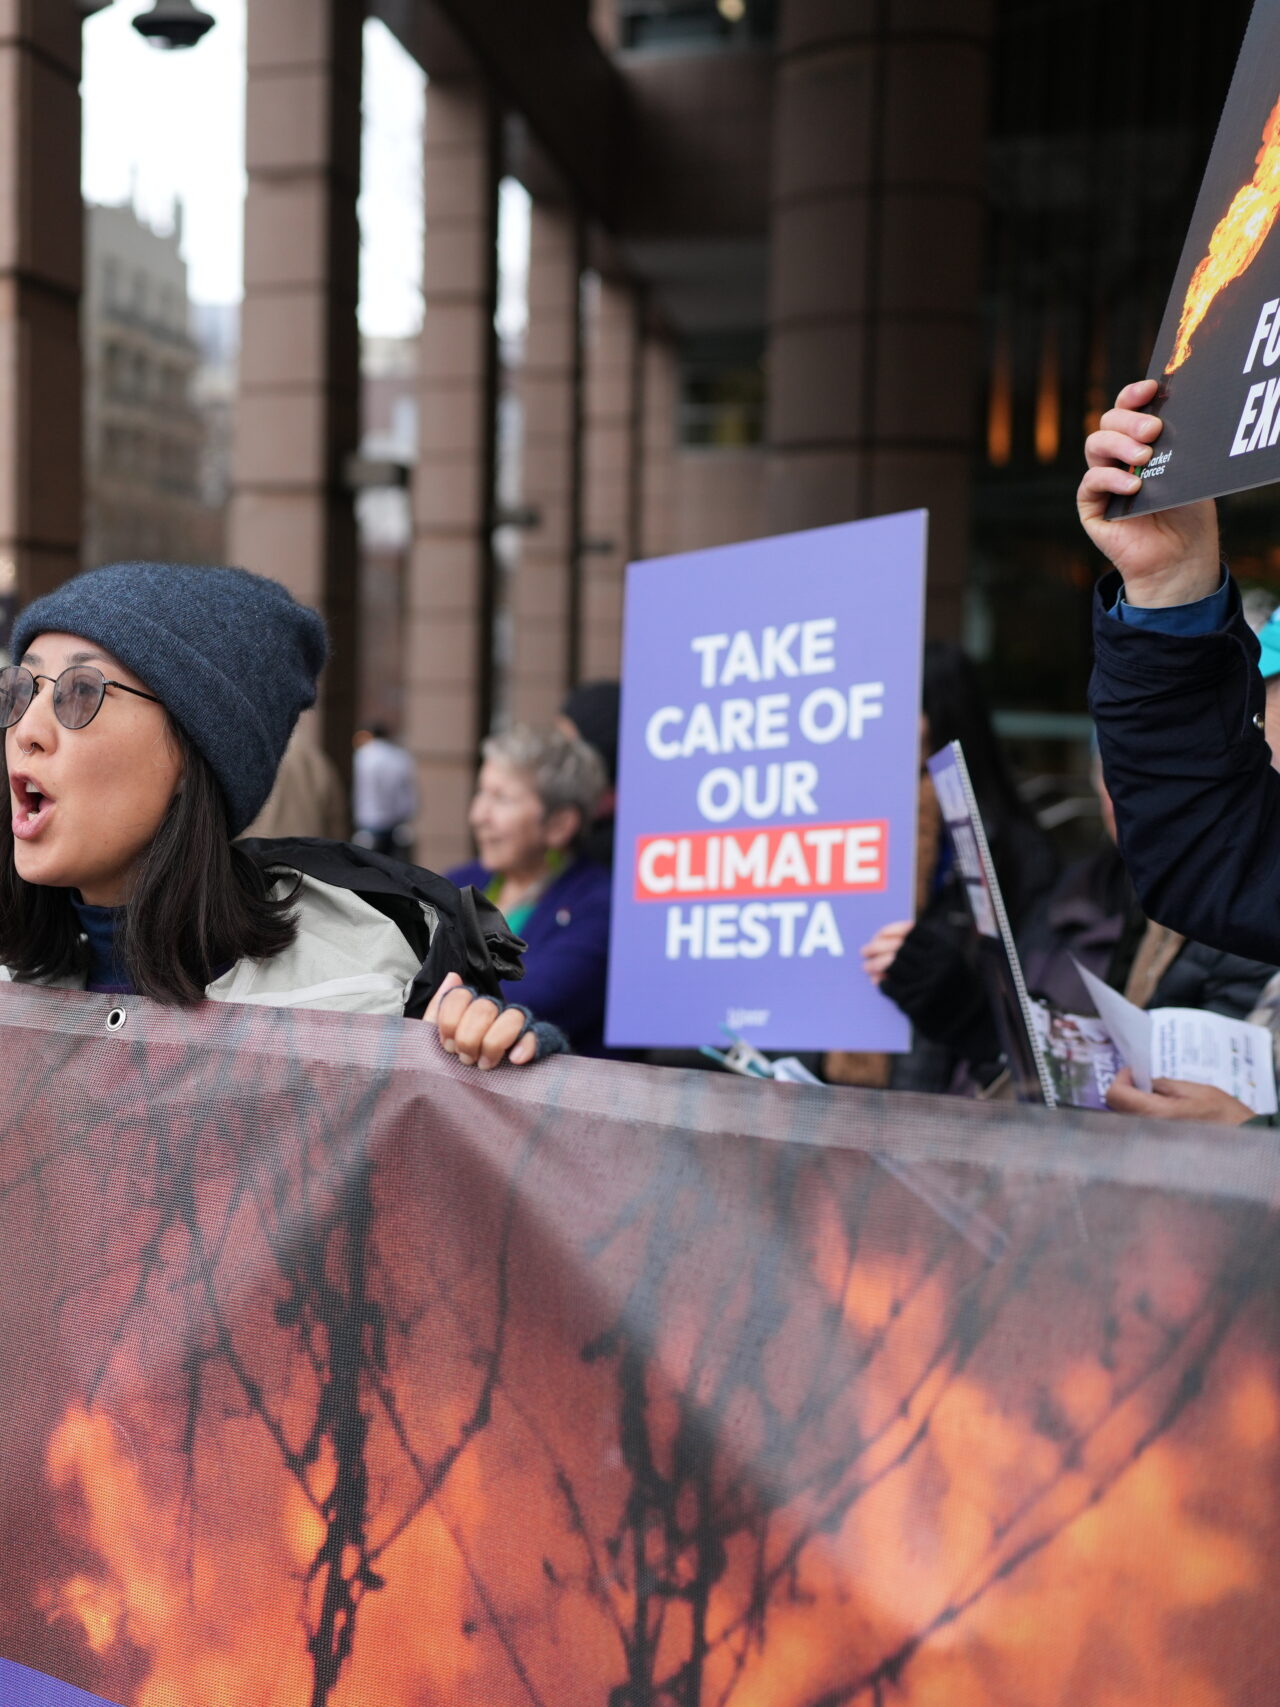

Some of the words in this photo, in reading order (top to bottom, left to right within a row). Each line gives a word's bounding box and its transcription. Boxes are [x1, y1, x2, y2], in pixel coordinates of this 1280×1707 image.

[691, 618, 836, 688] TAKE
[645, 694, 790, 761] CARE
[799, 682, 884, 744] OF
[697, 761, 818, 822] OUR
[639, 826, 880, 894] CLIMATE
[666, 902, 844, 959] HESTA
